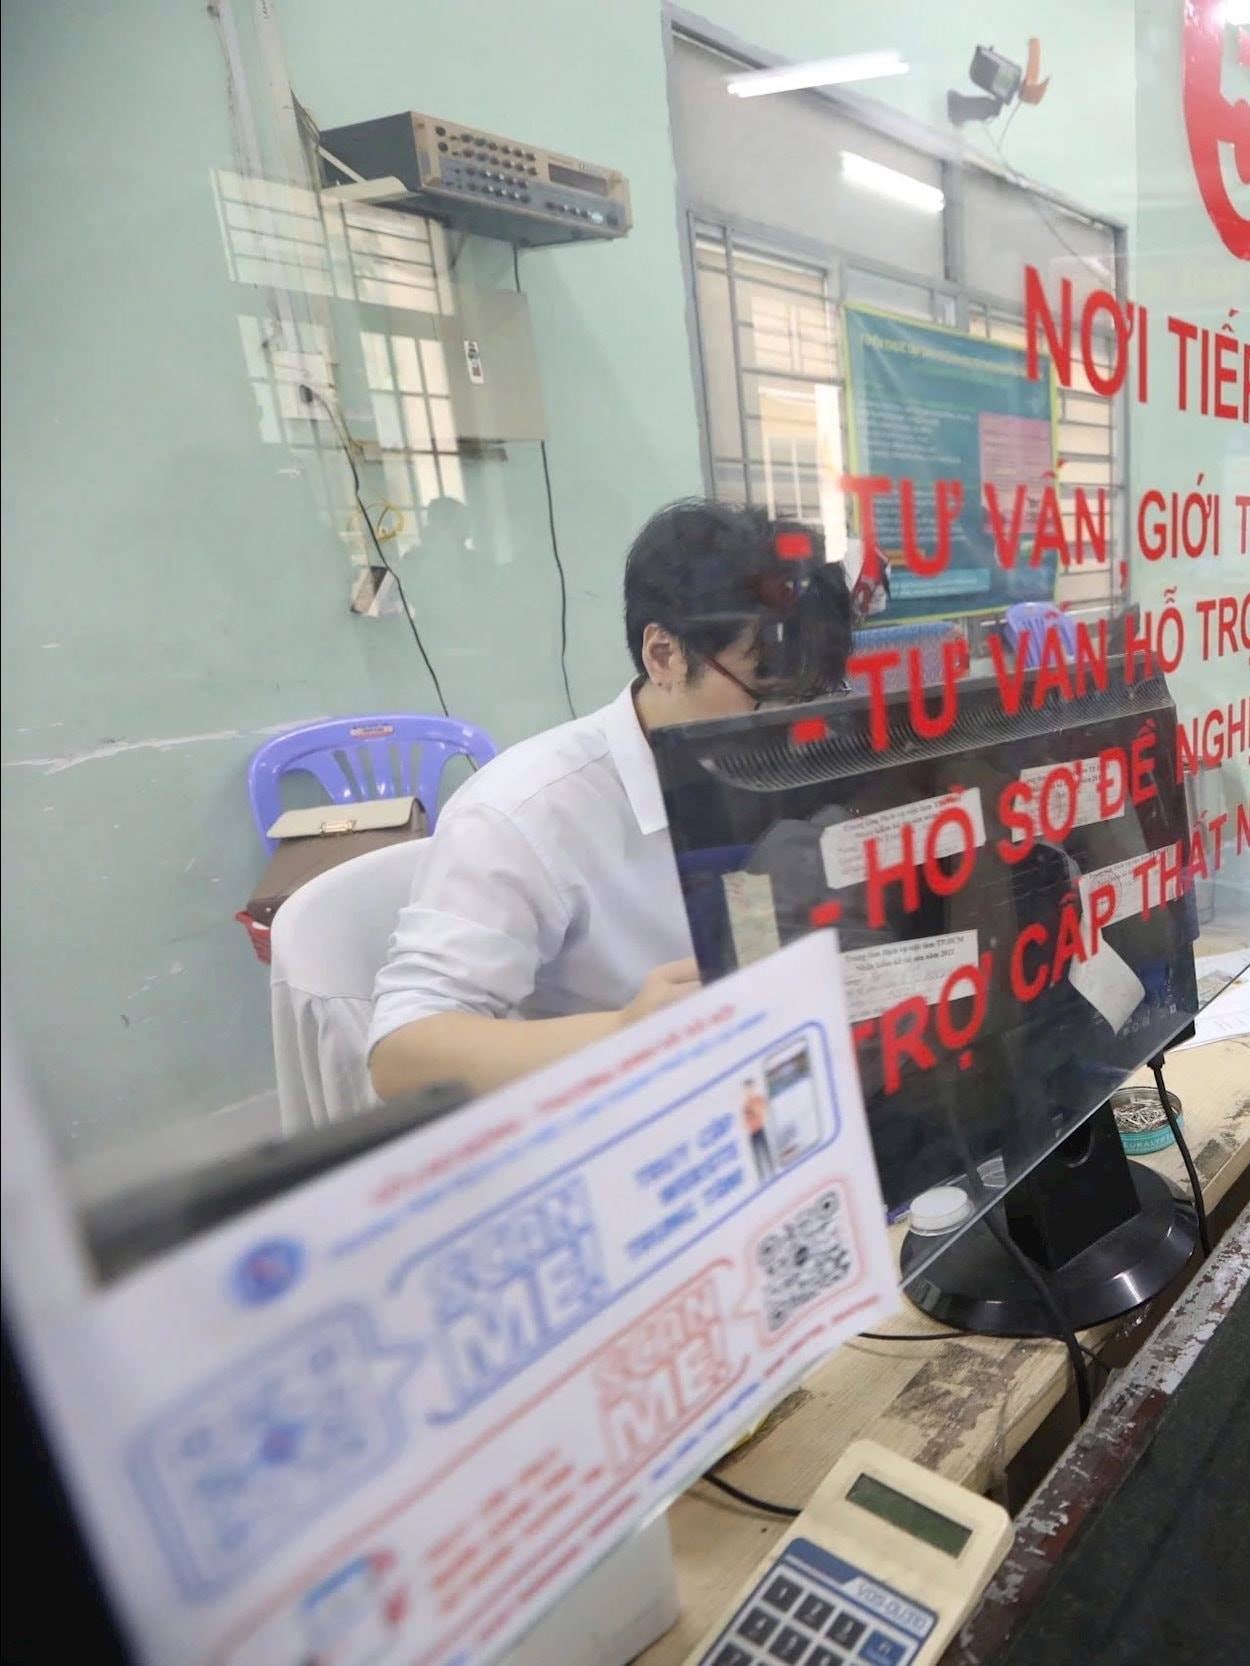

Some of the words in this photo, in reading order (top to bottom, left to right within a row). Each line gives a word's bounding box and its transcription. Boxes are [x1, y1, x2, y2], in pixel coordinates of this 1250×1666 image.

[1024, 265, 1149, 404] NƠI
[838, 474, 964, 586] TƯ
[1136, 474, 1222, 562] GIỚI
[845, 638, 971, 753] TƯ
[986, 602, 1110, 717] VẤN
[1124, 586, 1186, 685] HỖ
[863, 784, 978, 930] HỒ
[996, 759, 1084, 865] SƠ
[1095, 719, 1159, 821] ĐỀ
[1011, 877, 1119, 1003] CẤP
[1132, 809, 1229, 923] THẤT
